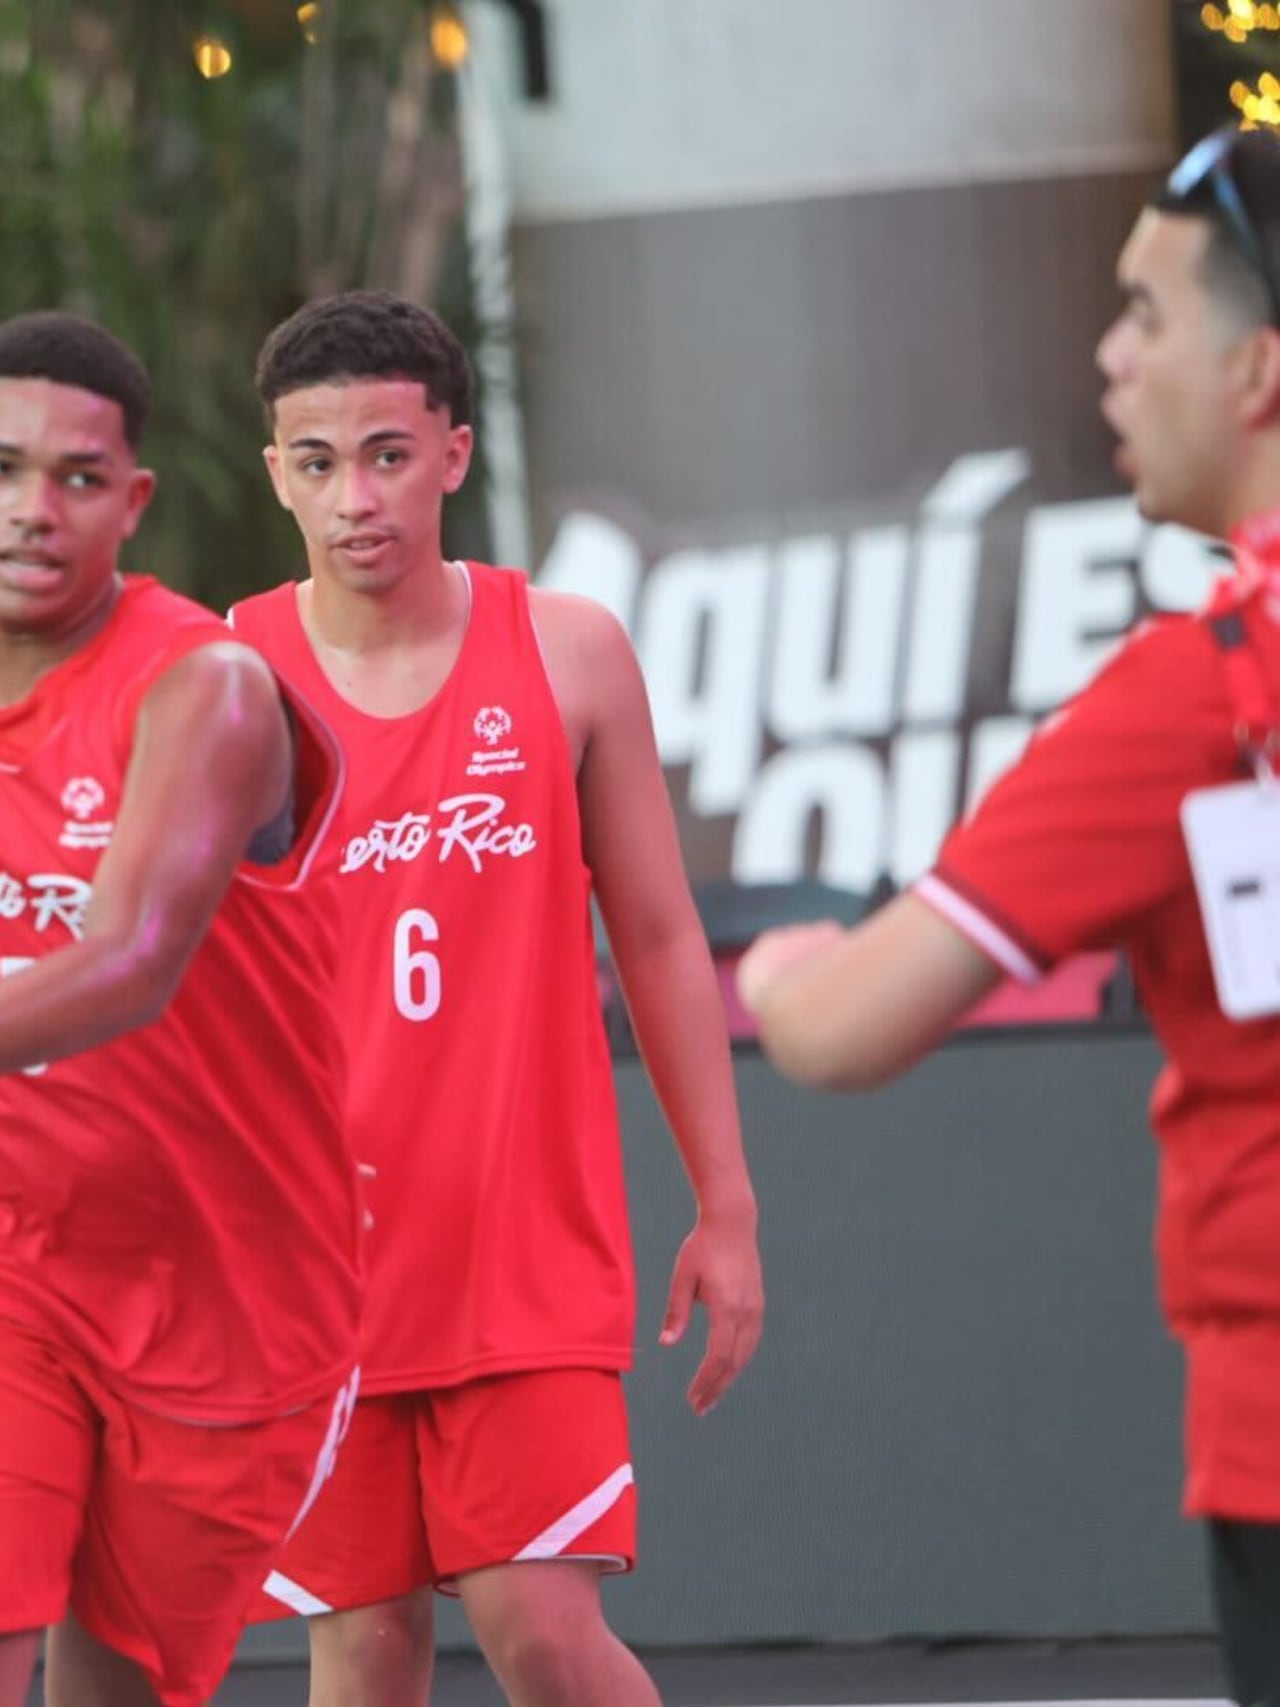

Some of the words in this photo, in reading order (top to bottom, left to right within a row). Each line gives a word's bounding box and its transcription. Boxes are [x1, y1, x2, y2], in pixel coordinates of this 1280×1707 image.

[339, 812, 431, 873] erto
[437, 793, 536, 873] Rico
[394, 908, 441, 1022] 6
